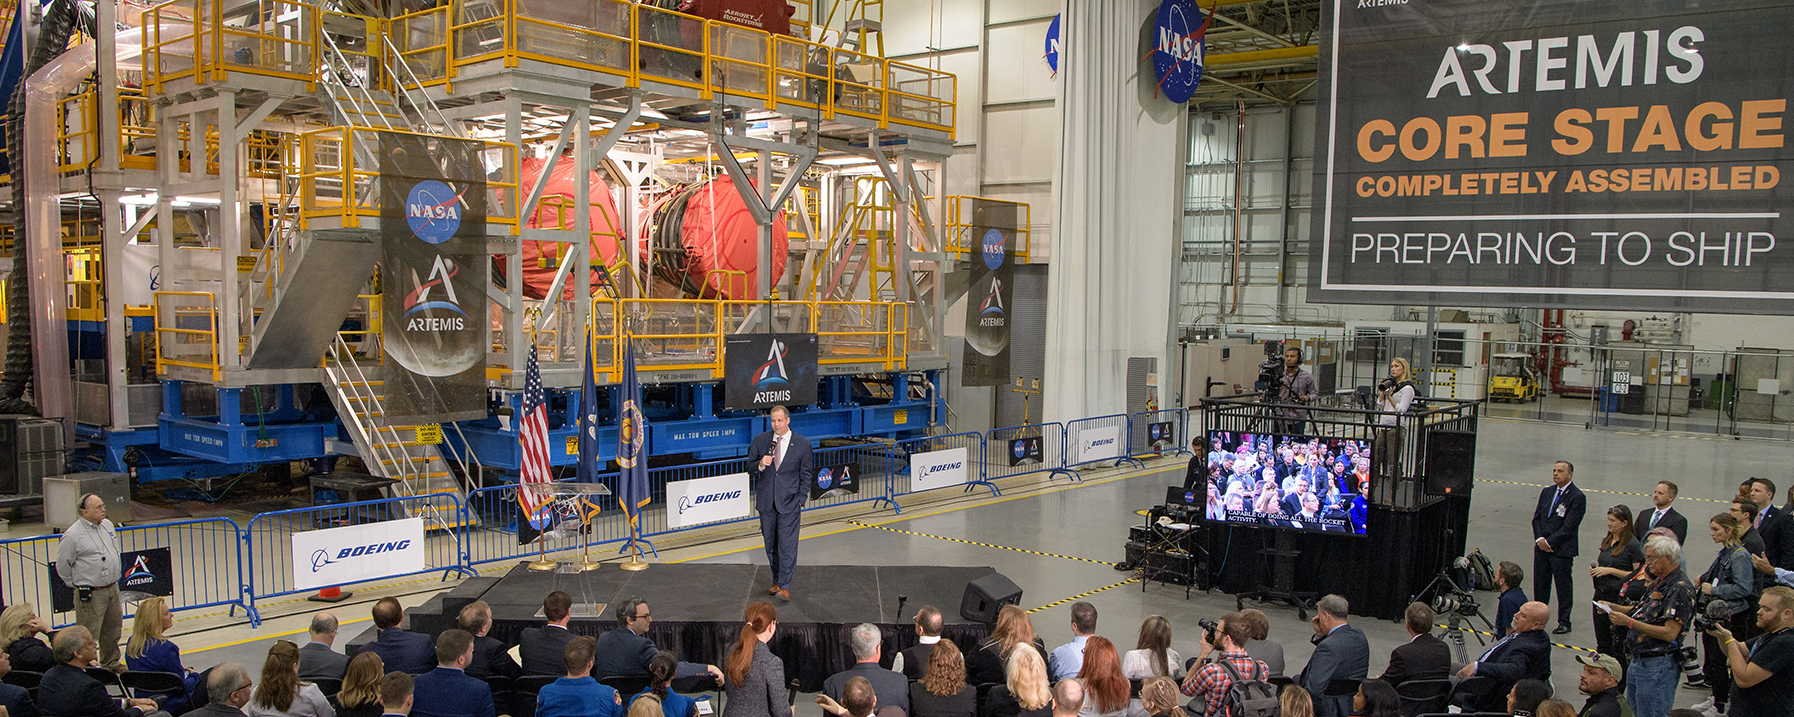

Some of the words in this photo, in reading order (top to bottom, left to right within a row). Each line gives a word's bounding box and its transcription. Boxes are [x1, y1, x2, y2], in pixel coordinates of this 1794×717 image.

[723, 14, 763, 28] ROCKETDYNE
[724, 9, 755, 20] AEROJET
[1159, 26, 1204, 67] NASA
[1426, 26, 1705, 98] ARTEMIS
[1357, 111, 1529, 163] CORE
[1551, 98, 1787, 156] STAGE
[1356, 169, 1558, 198] COMPLETELY
[1564, 164, 1780, 194] ASSEMBLED
[410, 203, 458, 220] NASA
[983, 244, 1004, 254] NASA
[1351, 231, 1576, 265] PREPARING
[1591, 231, 1651, 266] TO
[1666, 231, 1775, 267] SHIP
[406, 317, 464, 331] ARTEMIS
[980, 317, 1005, 327] ARTEMIS
[1616, 372, 1628, 382] 103
[753, 390, 791, 404] ARTEMIS
[703, 430, 719, 438] SPEED
[1091, 438, 1114, 447] BOEING
[930, 462, 962, 473] BOEING
[694, 490, 742, 504] BOEING
[1228, 510, 1256, 518] CAPABLE
[1319, 518, 1346, 526] ROCKET
[1228, 515, 1258, 523] ACTIVITY.
[336, 539, 410, 559] BOEING
[126, 576, 153, 586] ARTEMIS
